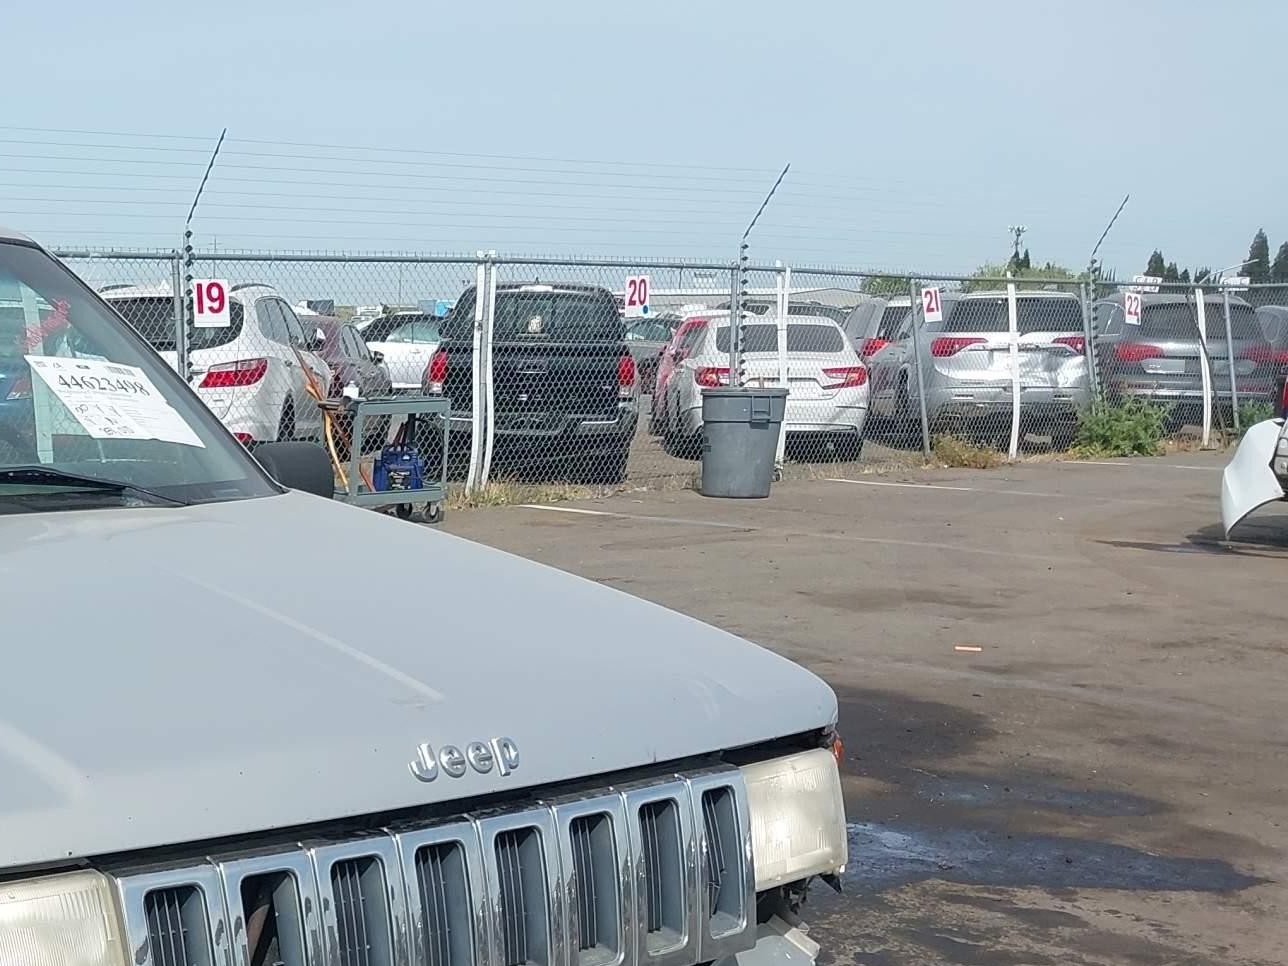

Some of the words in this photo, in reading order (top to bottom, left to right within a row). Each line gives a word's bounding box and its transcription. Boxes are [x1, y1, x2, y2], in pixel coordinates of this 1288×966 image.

[196, 282, 225, 315] 19
[628, 278, 647, 306] 20
[924, 290, 940, 313] 21
[1127, 295, 1140, 316] 22
[58, 374, 151, 397] 44623498
[409, 737, 520, 783] Jeep
